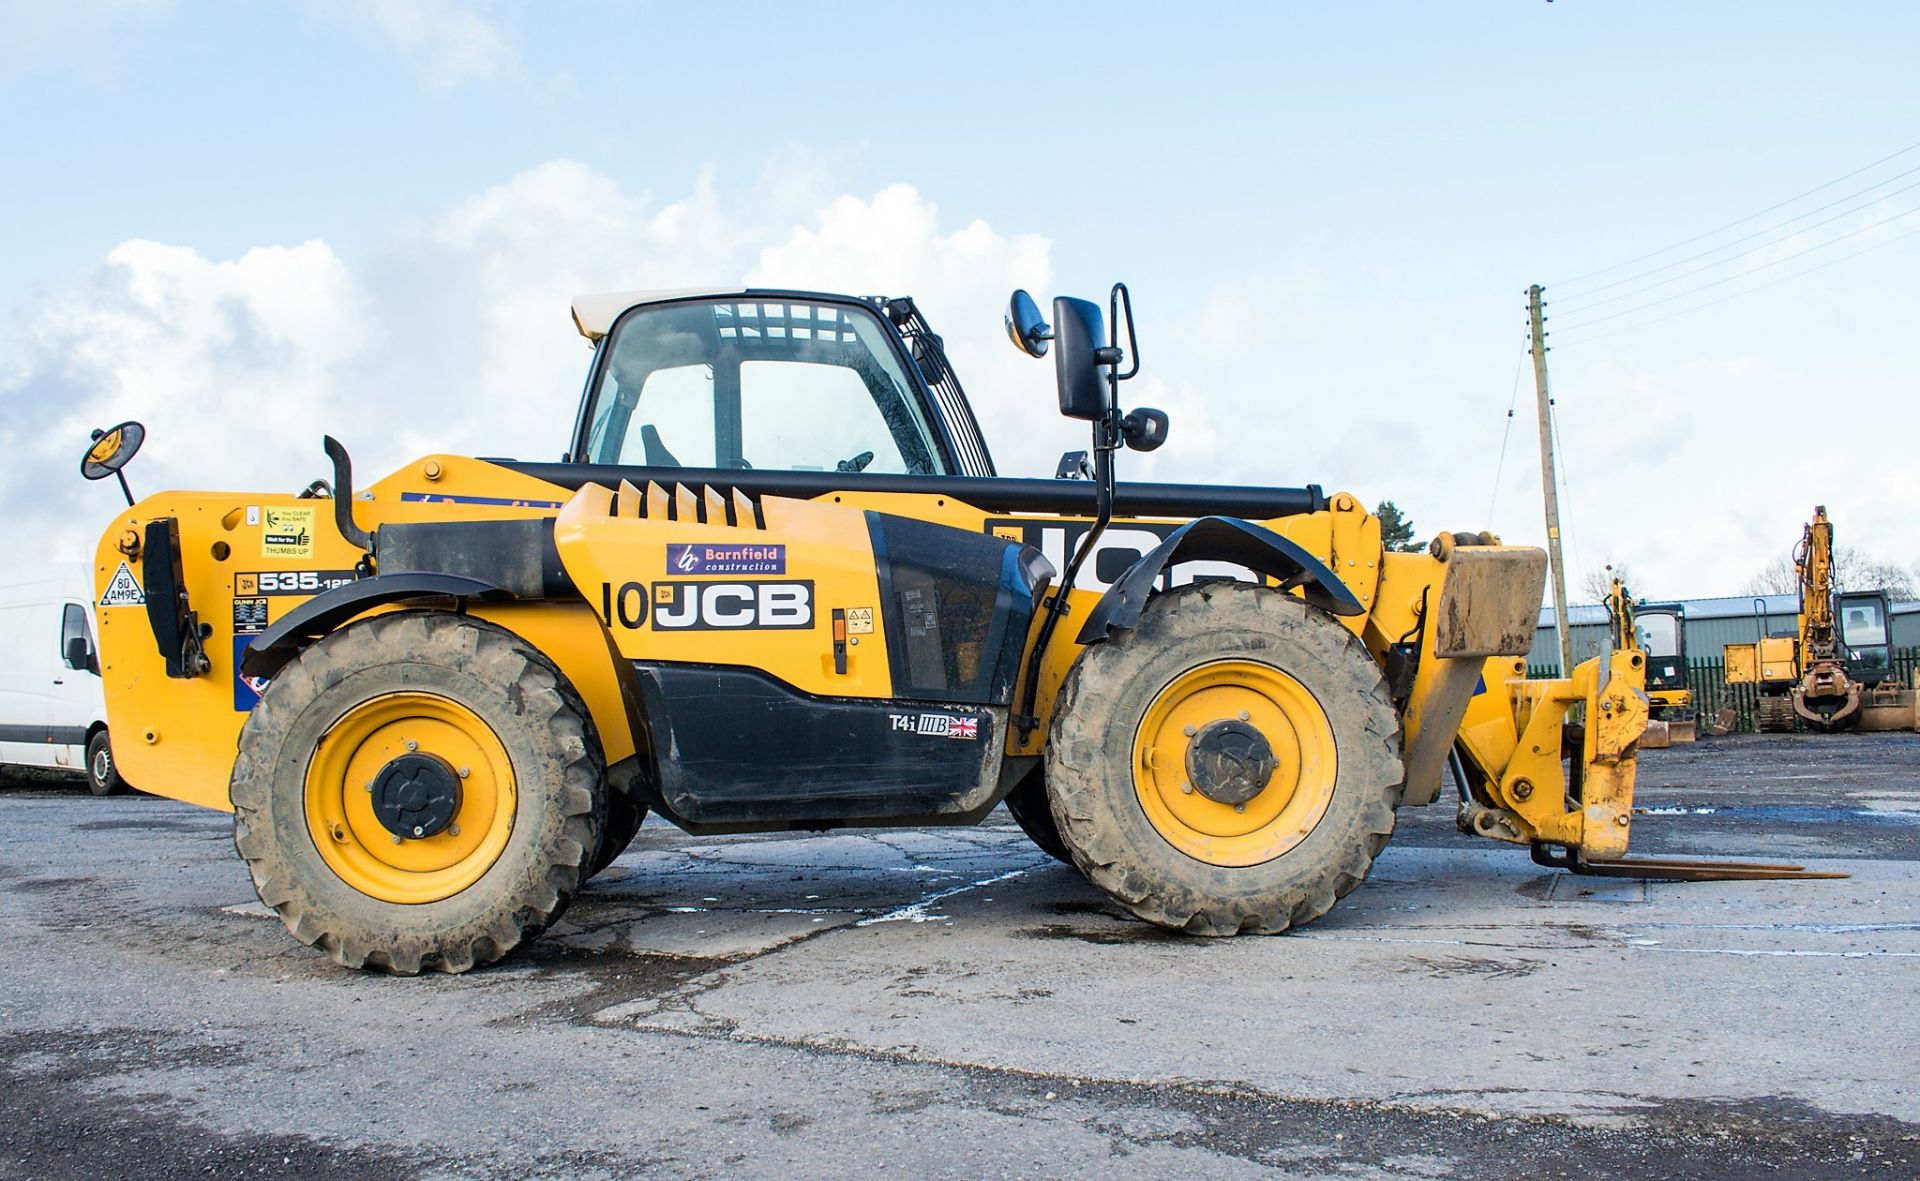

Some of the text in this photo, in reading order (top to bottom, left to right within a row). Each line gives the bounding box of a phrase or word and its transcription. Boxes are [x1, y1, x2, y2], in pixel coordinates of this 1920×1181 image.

[266, 547, 297, 555] THUMBS
[705, 548, 777, 560] Barnfield
[705, 562, 777, 571] construction
[655, 584, 811, 627] JCB
[889, 714, 917, 732] T4i
